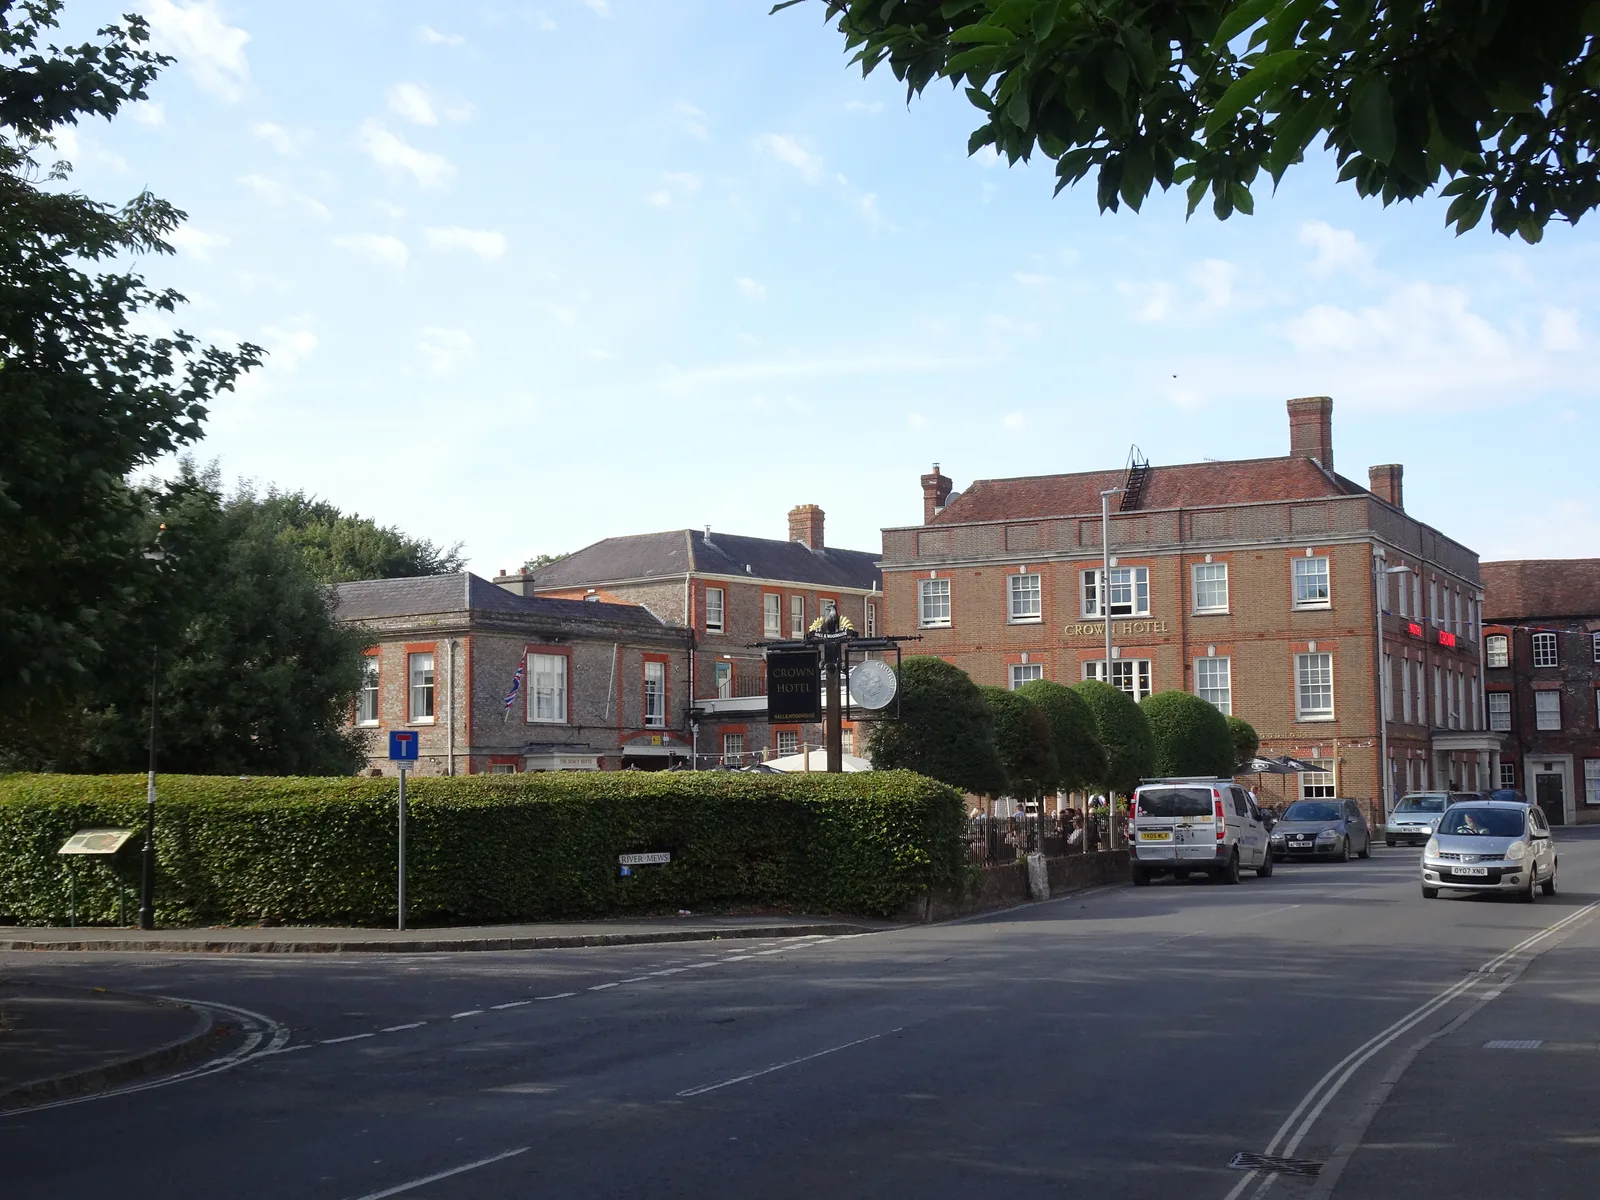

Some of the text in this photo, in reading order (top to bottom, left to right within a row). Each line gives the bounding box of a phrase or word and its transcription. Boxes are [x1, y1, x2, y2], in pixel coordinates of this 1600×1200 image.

[1064, 620, 1168, 636] CROWN HOTEL
[772, 668, 815, 678] CROWN
[777, 683, 811, 693] HOTEL
[621, 853, 668, 864] RIVER MEWS
